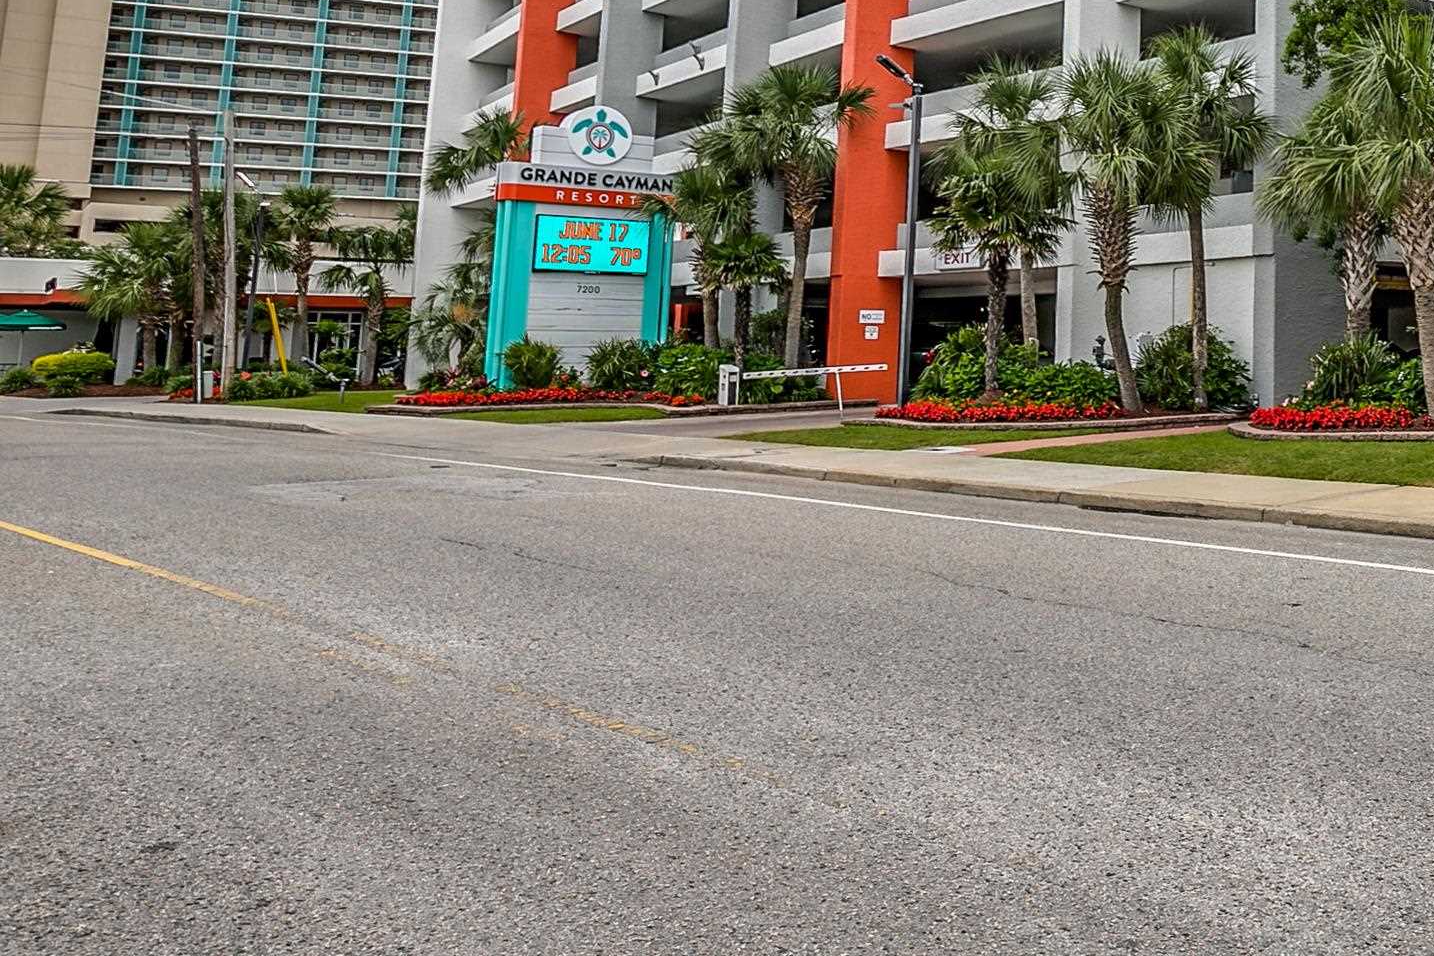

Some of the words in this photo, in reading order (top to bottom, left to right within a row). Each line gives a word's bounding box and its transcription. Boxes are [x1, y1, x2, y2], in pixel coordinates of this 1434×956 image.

[520, 167, 597, 186] GRANDE
[602, 174, 673, 192] CAYMAN
[556, 190, 637, 206] RESORT
[559, 220, 603, 241] JUNE
[608, 222, 629, 242] 17
[541, 244, 591, 265] 12:05
[944, 252, 970, 265] EXIT
[576, 284, 601, 295] 7200
